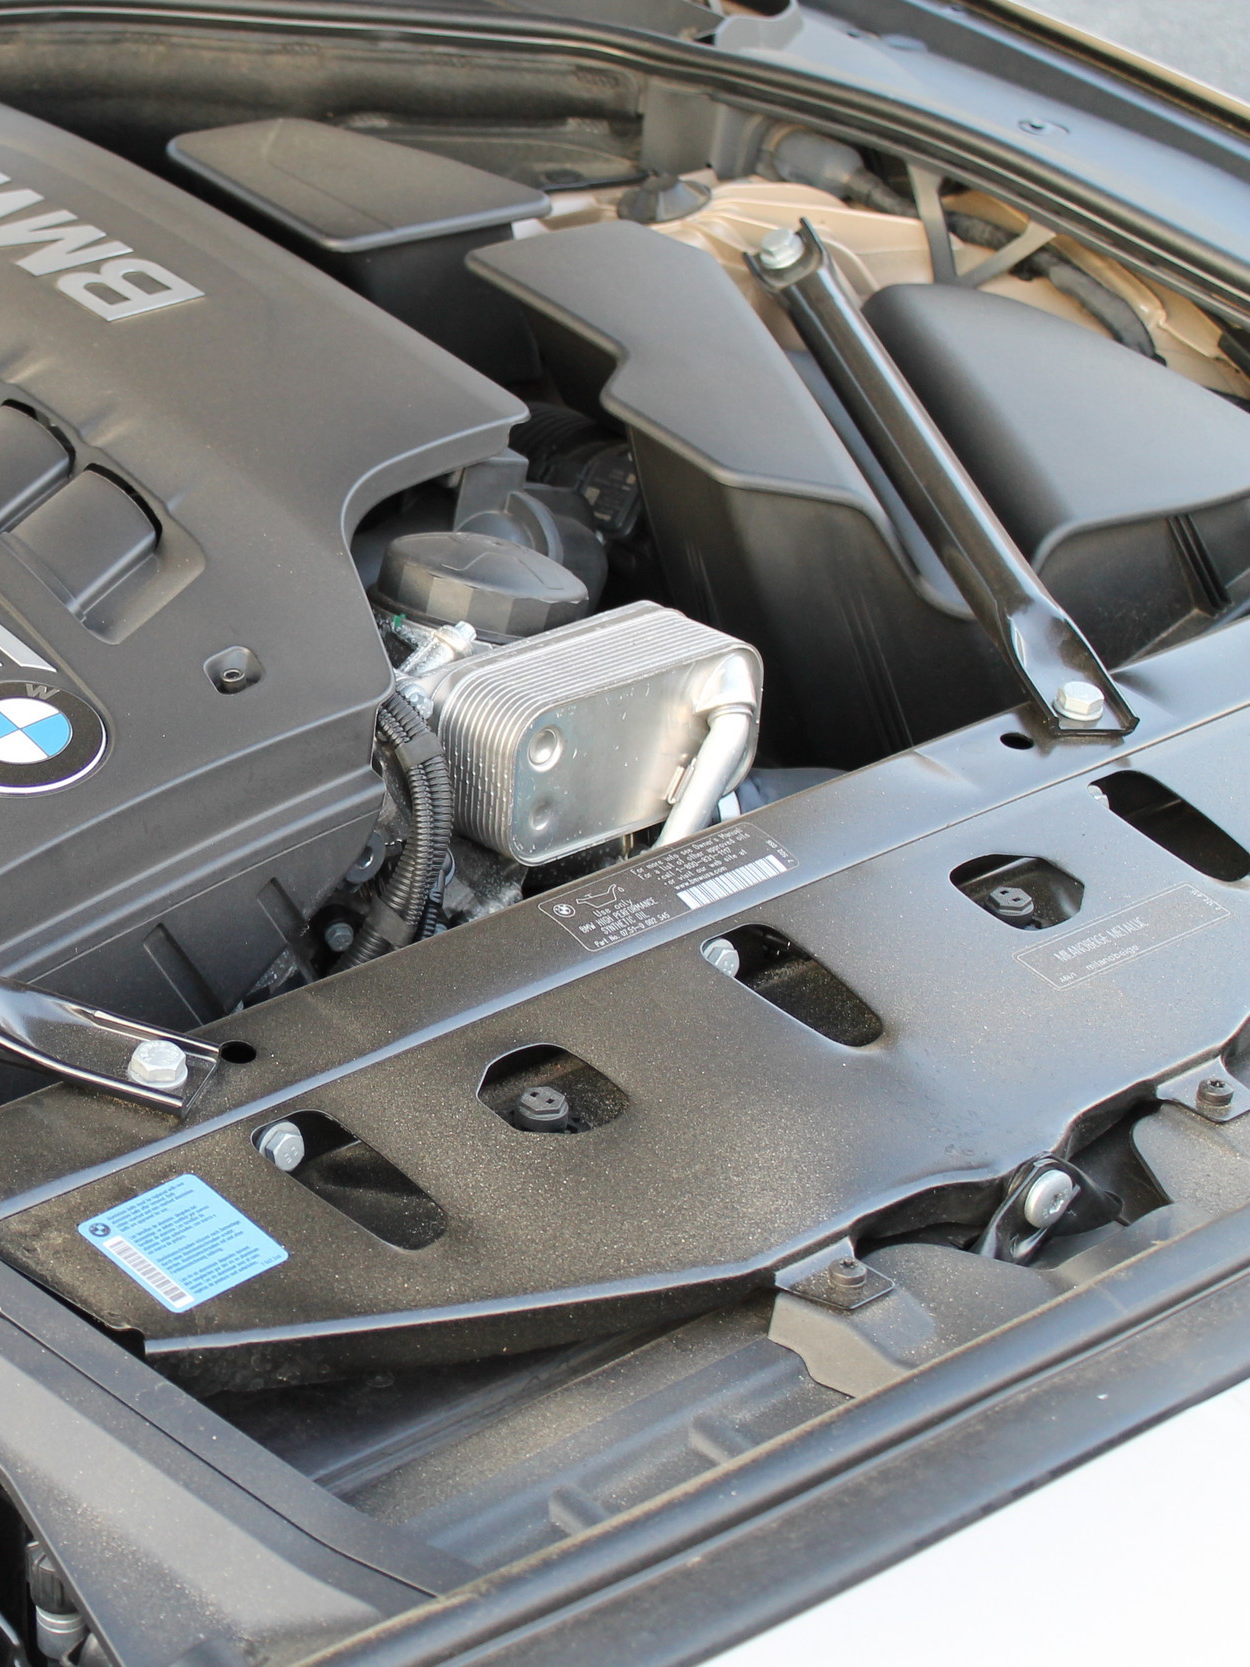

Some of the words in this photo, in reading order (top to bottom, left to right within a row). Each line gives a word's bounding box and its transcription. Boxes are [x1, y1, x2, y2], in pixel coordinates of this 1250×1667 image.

[659, 862, 675, 871] list
[687, 851, 704, 861] other
[706, 838, 735, 853] approved
[630, 867, 644, 875] For
[678, 871, 694, 880] visit
[579, 922, 596, 933] BMW
[596, 915, 614, 926] HIGH
[613, 897, 658, 919] PERFORMANCE
[593, 908, 611, 917] Use
[614, 899, 633, 910] only
[601, 916, 636, 934] SYNTHETIC
[635, 911, 650, 920] OIL
[594, 938, 609, 947] Part
